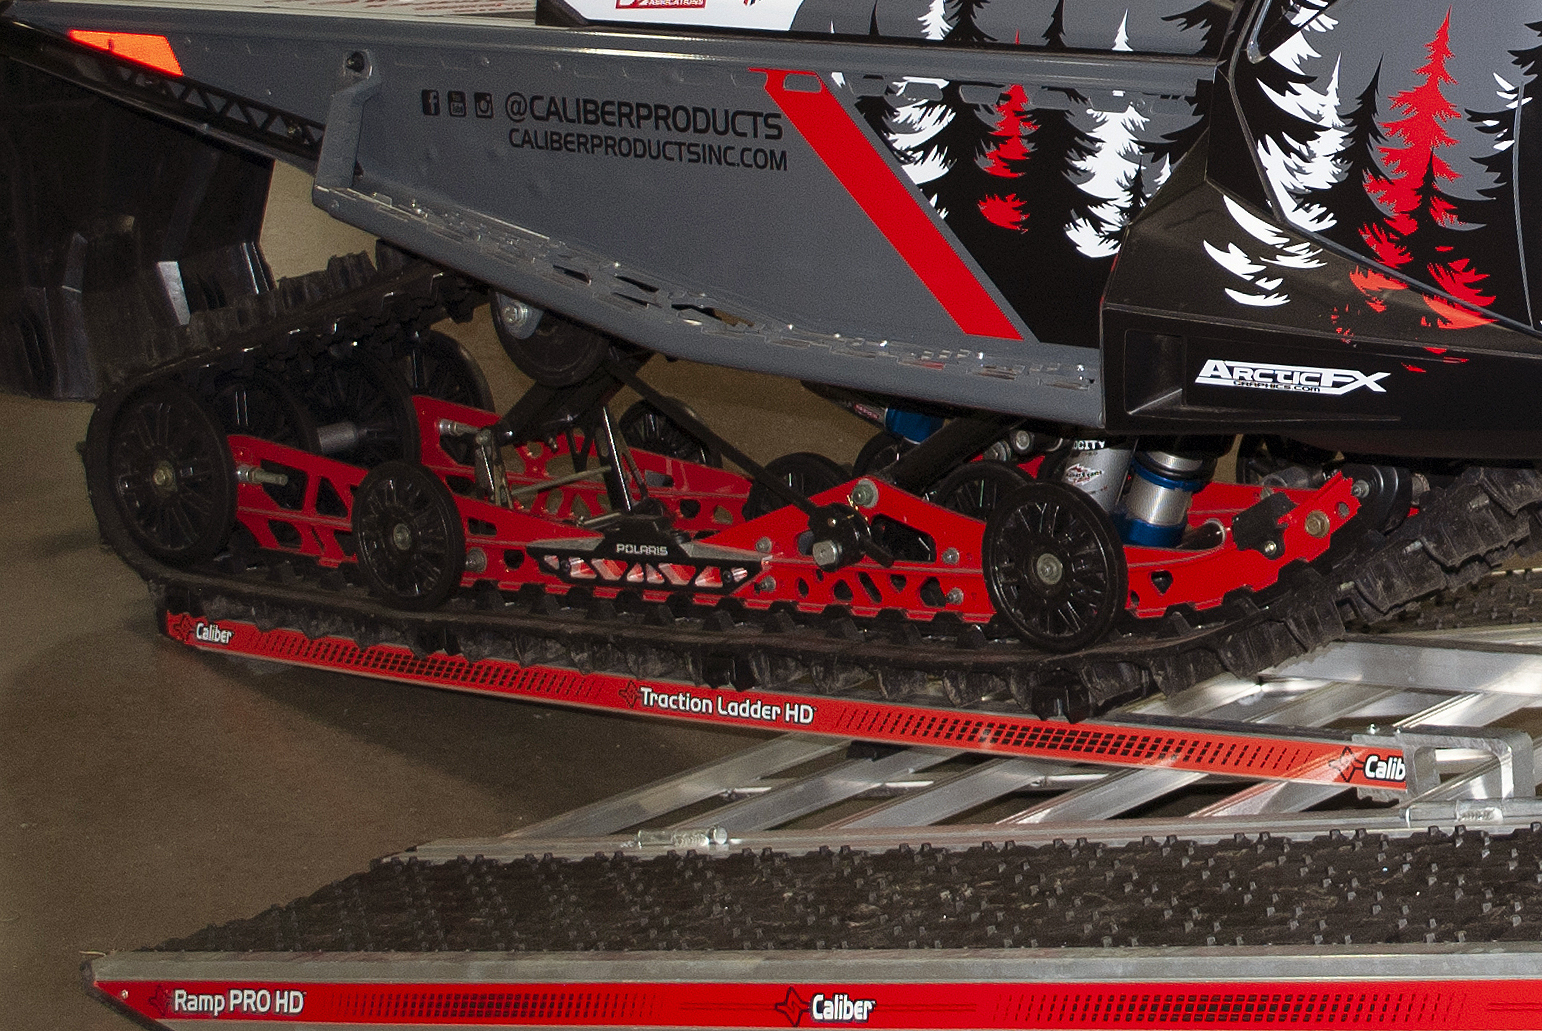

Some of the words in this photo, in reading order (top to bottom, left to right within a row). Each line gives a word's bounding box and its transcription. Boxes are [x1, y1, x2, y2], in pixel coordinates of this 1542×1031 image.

[504, 91, 784, 141] @CALIBERPRODUCTS
[508, 128, 789, 172] CALIBERPRODUCTSINC.COM
[615, 543, 669, 557] POLARIS
[195, 622, 233, 645] Caliber
[640, 687, 713, 714] Traction
[716, 696, 782, 722] Ladder
[785, 702, 815, 725] HD
[172, 989, 226, 1017] Ramp
[228, 988, 271, 1014] PRO
[274, 989, 304, 1015] HD
[810, 993, 873, 1024] Caliber
